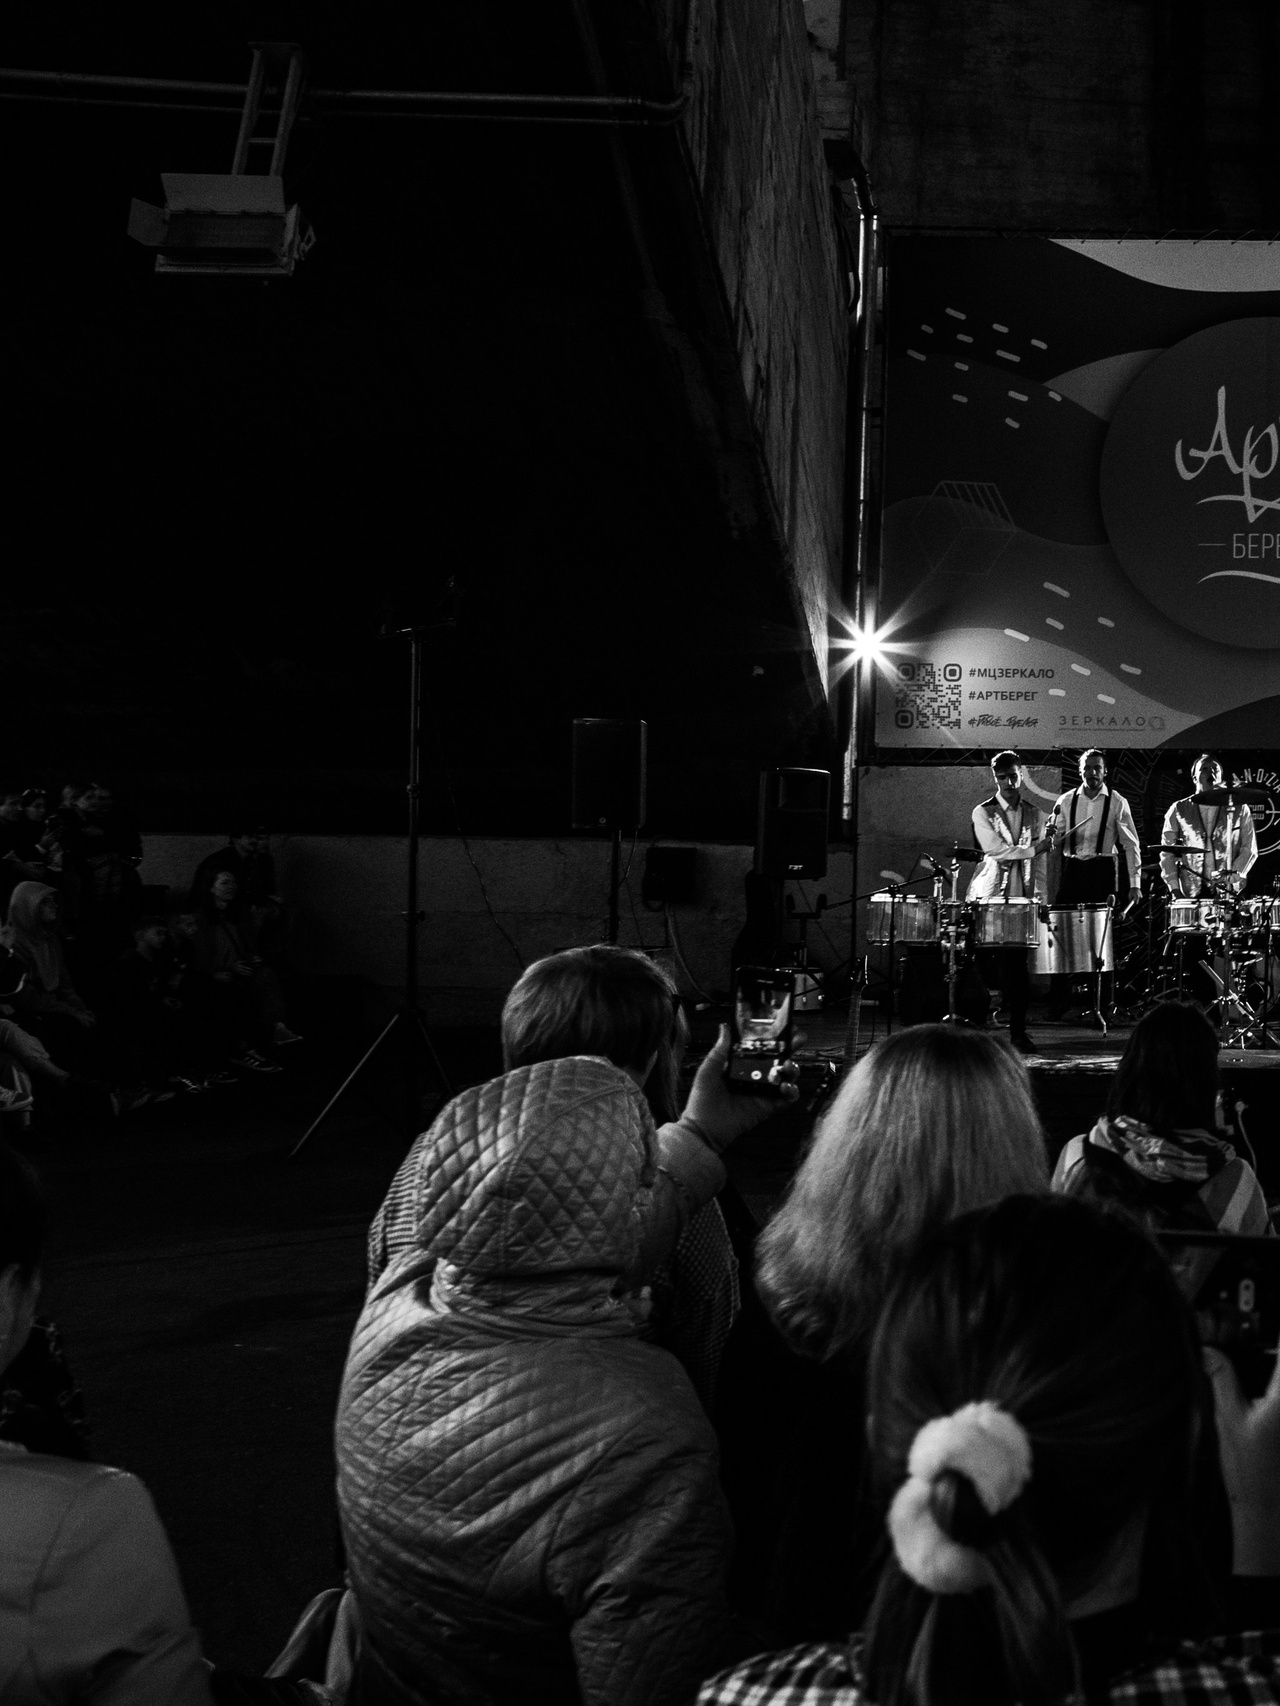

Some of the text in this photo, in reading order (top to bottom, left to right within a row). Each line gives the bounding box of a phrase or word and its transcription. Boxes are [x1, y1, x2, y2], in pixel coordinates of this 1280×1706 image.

[968, 667, 1055, 680] #МЦЗЕРКАЛО
[968, 690, 1038, 701] #АРТБЕРЕГ
[1058, 715, 1146, 727] ЗЕРКАЛО
